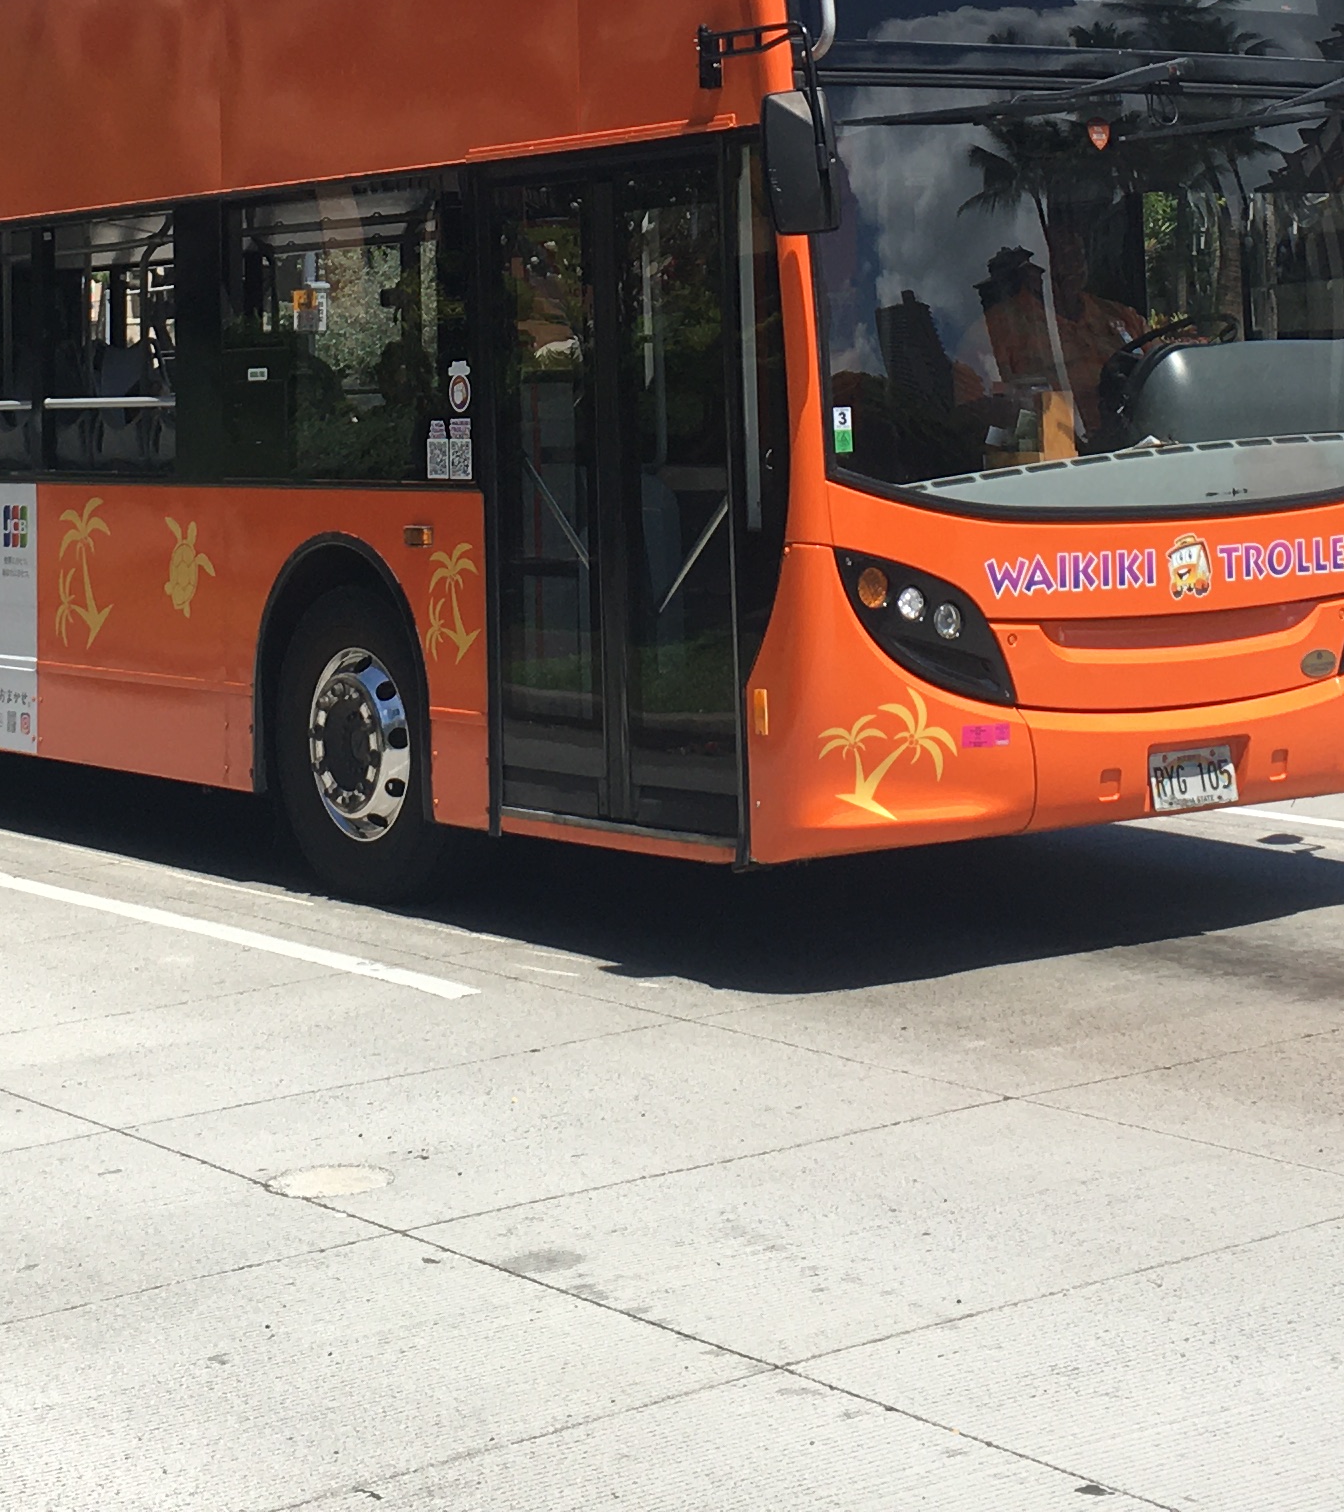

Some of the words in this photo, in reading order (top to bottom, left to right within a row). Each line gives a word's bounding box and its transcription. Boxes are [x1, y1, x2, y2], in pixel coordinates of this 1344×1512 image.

[838, 411, 847, 426] 3
[984, 548, 1156, 600] WAIKIKI
[1154, 765, 1187, 797] RYG
[1198, 759, 1232, 792] 105
